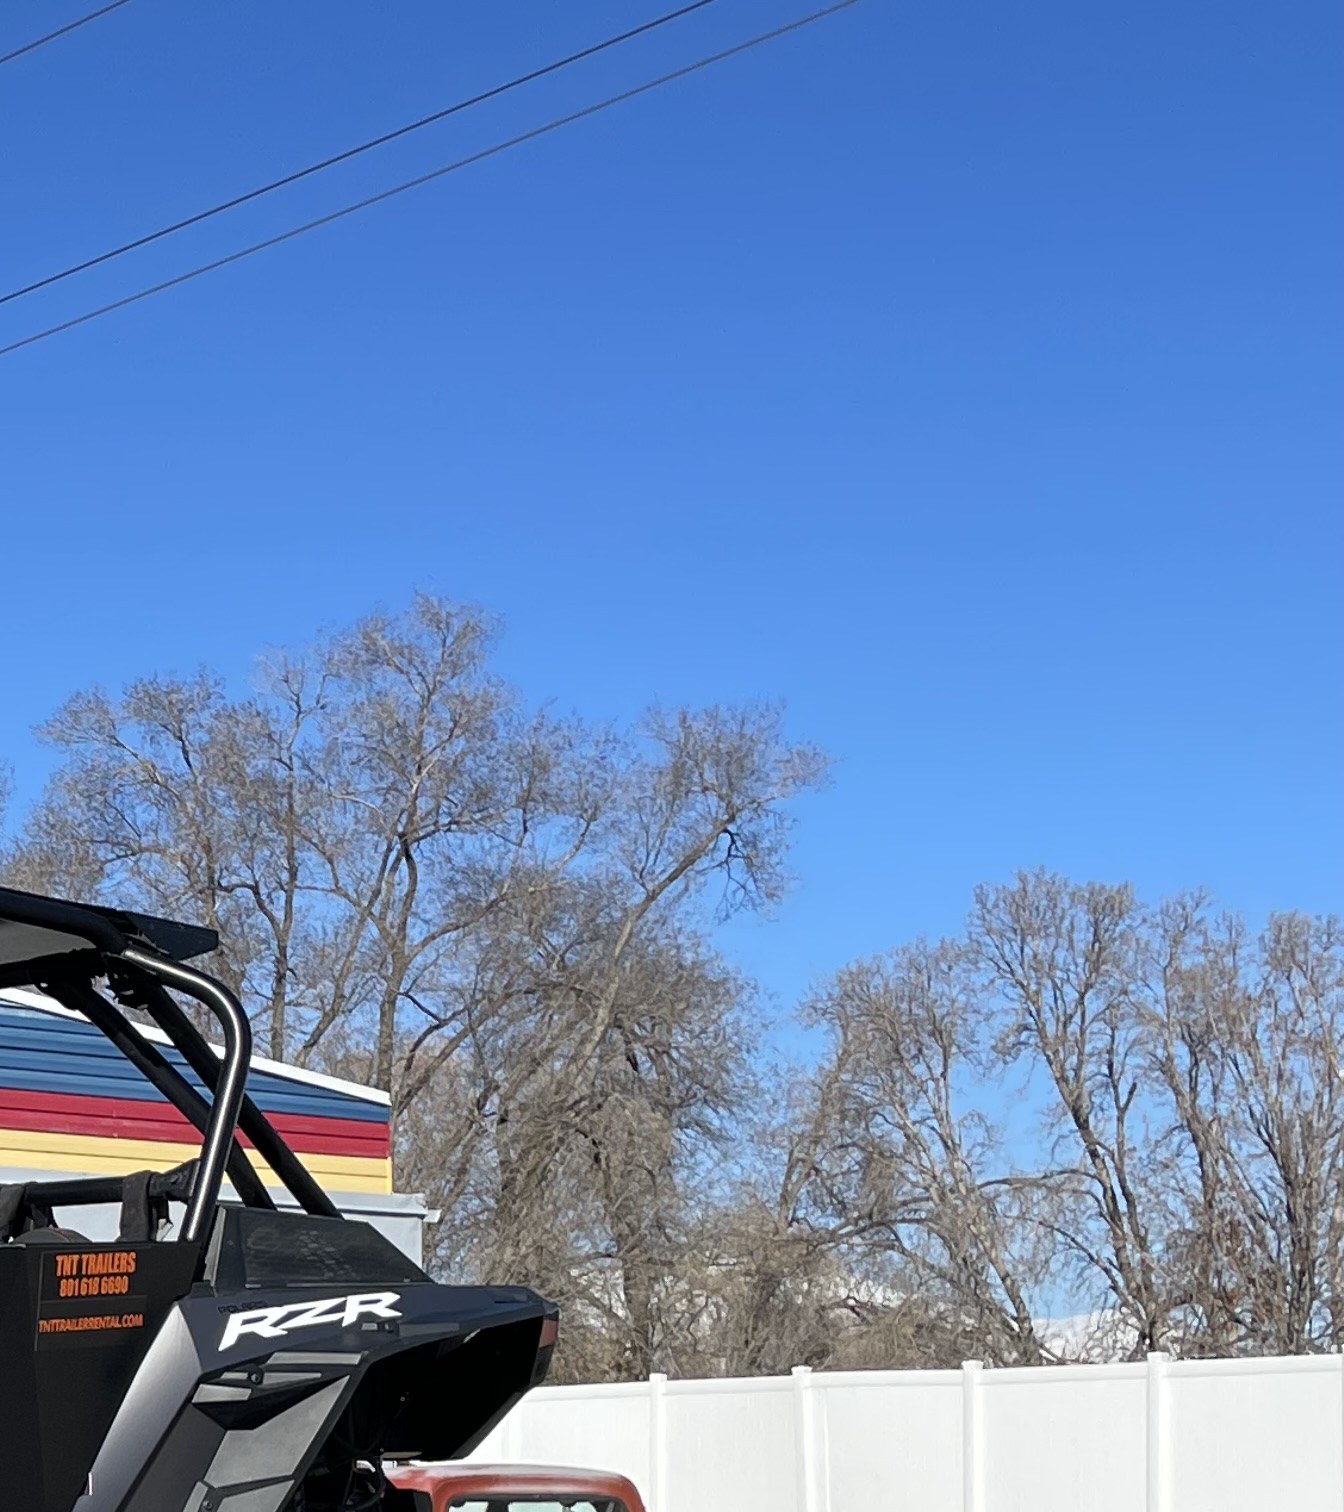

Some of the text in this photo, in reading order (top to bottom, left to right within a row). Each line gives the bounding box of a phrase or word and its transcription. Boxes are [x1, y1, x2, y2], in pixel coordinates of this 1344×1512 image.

[56, 1252, 137, 1277] TNT TRAILERS
[60, 1275, 129, 1297] 801 618 6690
[218, 1291, 403, 1352] RZR
